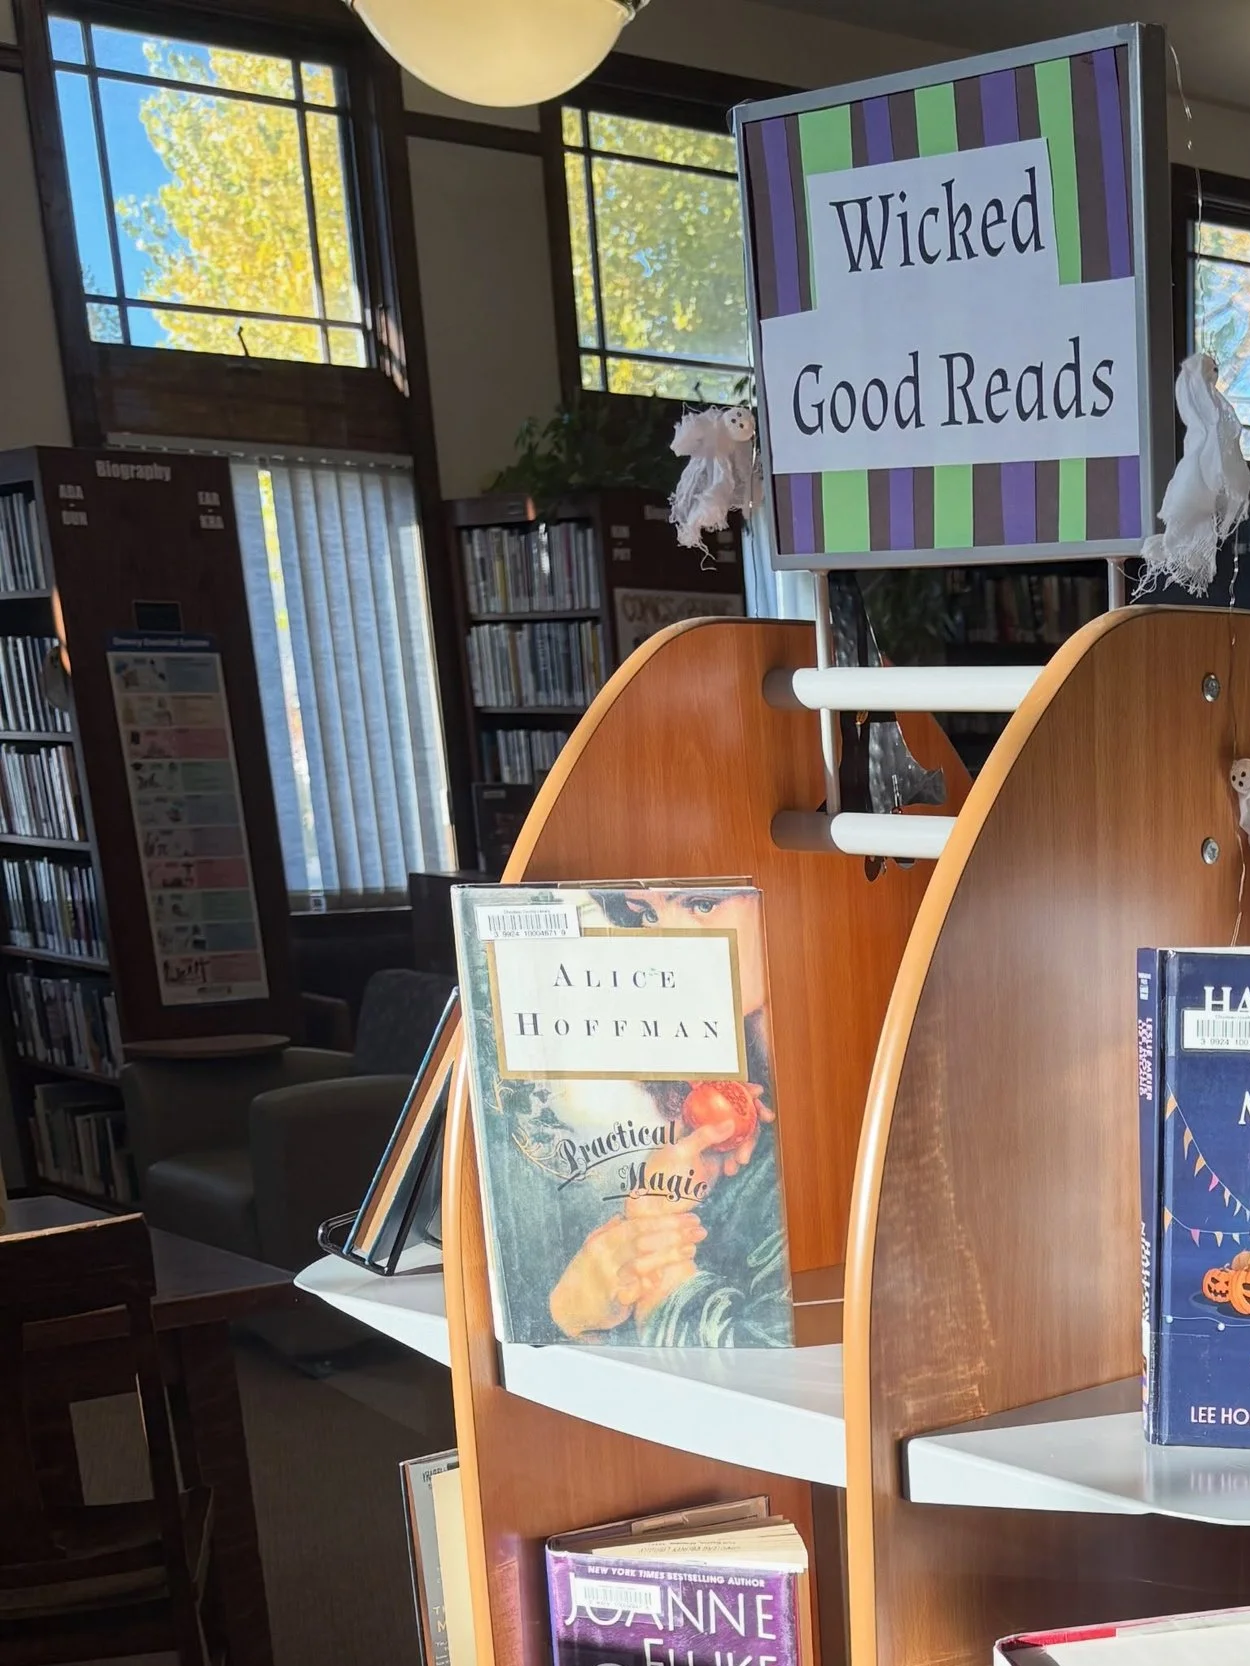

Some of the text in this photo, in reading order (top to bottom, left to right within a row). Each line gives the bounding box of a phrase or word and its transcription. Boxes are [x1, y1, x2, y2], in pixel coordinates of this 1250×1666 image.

[829, 167, 1045, 273] Wicked
[793, 337, 1114, 435] Good Reads
[95, 460, 171, 482] Biography
[552, 962, 677, 989] ALICE
[513, 1011, 720, 1039] HOFFMAN
[556, 1121, 679, 1178] Practical
[617, 1161, 709, 1202] Magic
[1190, 1406, 1216, 1424] LEE
[588, 1565, 766, 1588] NEW YORK TIMES BESTSELLING AUTHOR
